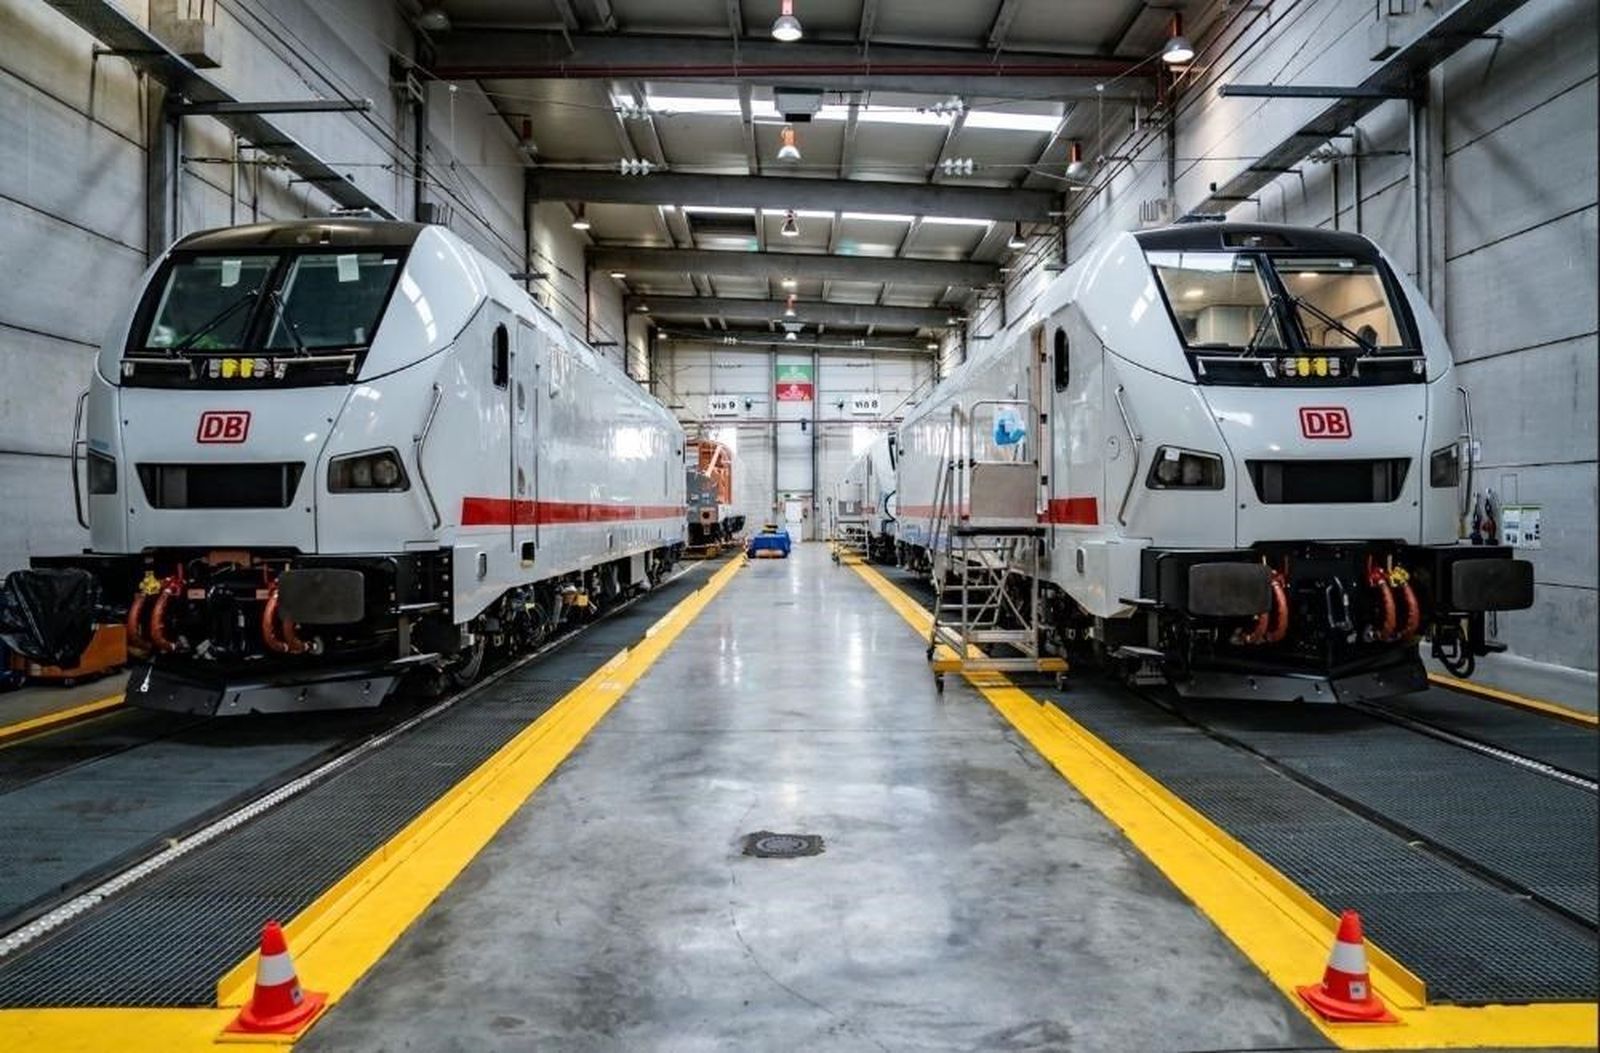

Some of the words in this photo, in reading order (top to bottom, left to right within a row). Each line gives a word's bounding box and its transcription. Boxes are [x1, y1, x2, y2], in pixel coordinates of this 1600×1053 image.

[728, 400, 736, 410] 9
[871, 399, 879, 409] 8
[202, 415, 244, 439] DB
[1305, 412, 1346, 434] DB
